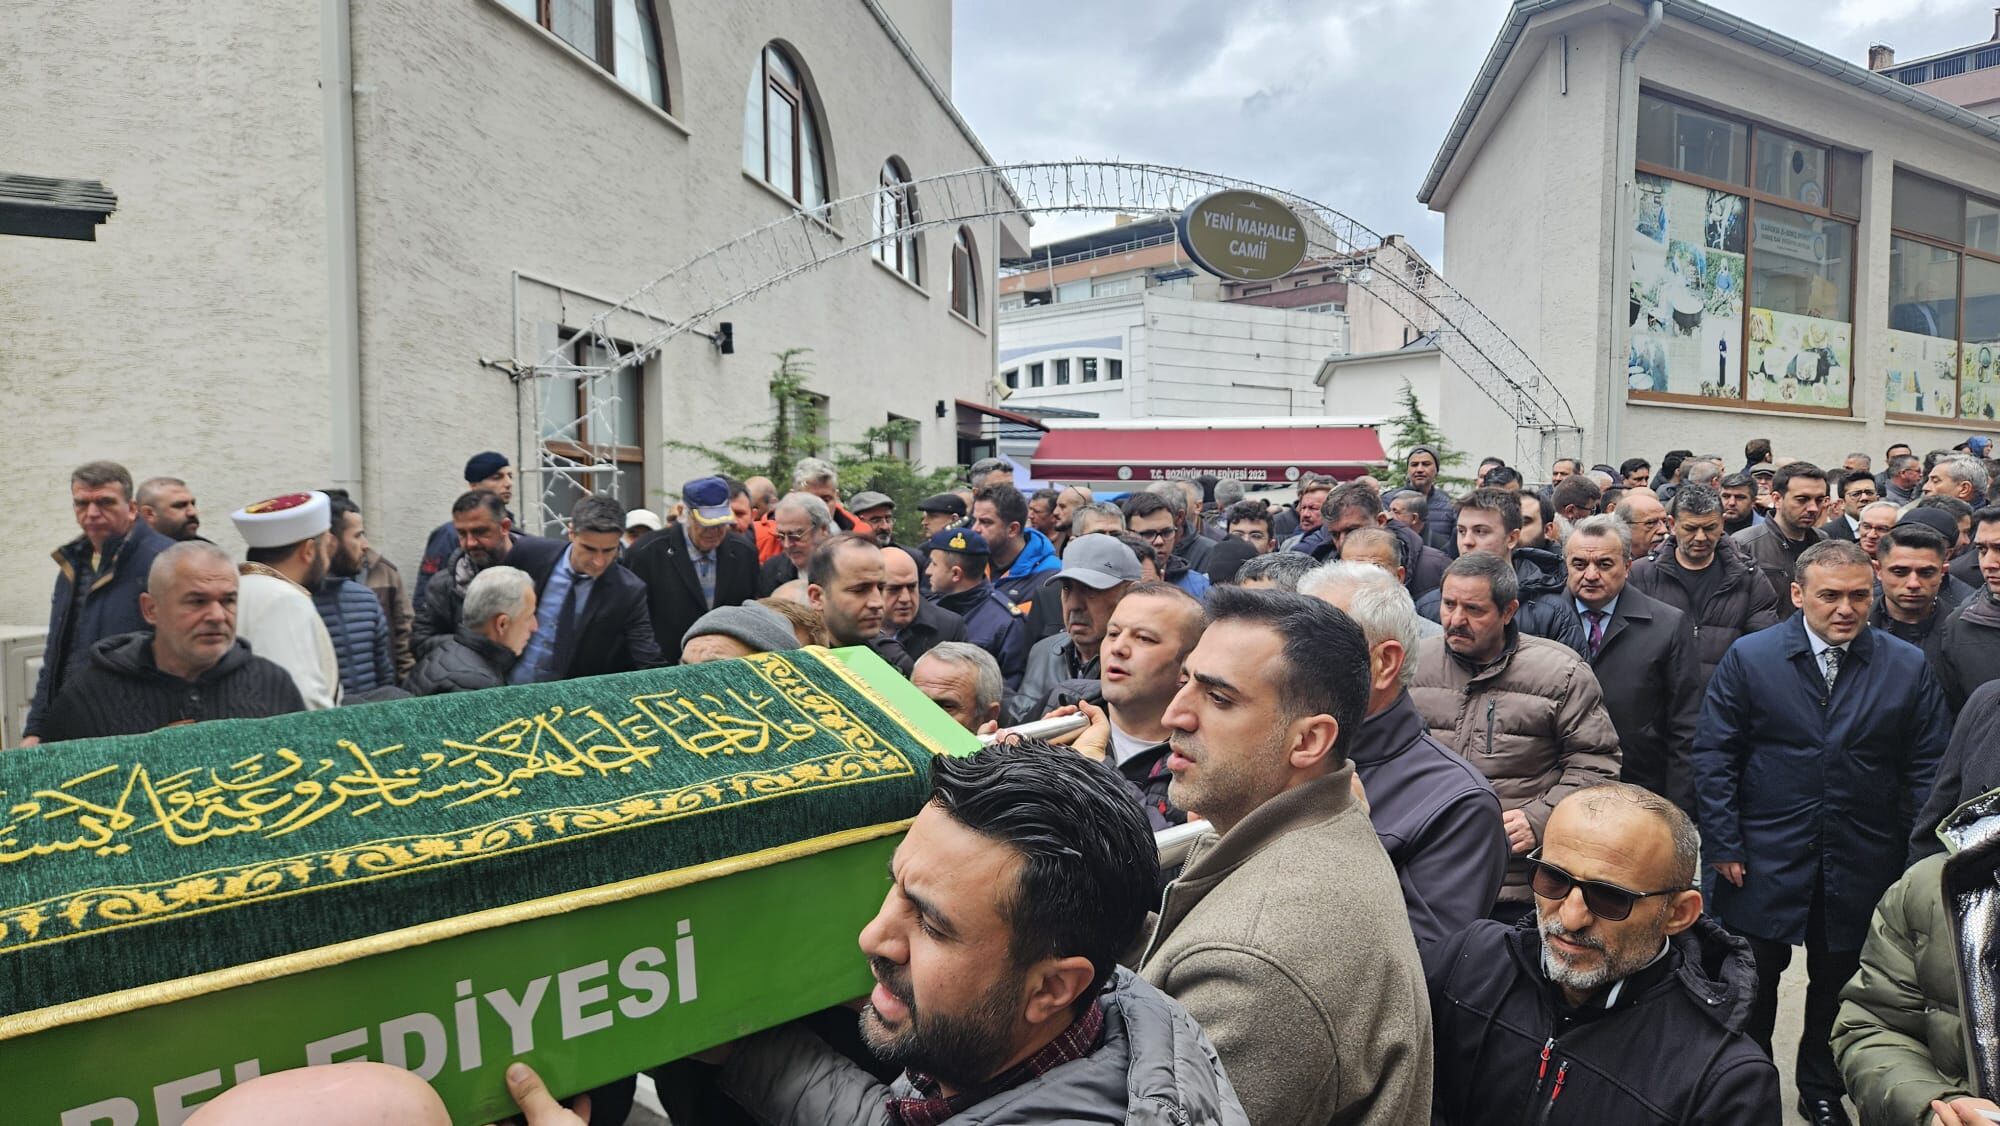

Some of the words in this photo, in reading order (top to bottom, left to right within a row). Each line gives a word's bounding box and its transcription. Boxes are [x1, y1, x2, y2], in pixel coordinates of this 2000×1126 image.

[1203, 211, 1235, 232] YENİ
[1236, 218, 1297, 242] MAHALLE
[1150, 469, 1164, 480] T.C.
[1247, 469, 1267, 480] 2023
